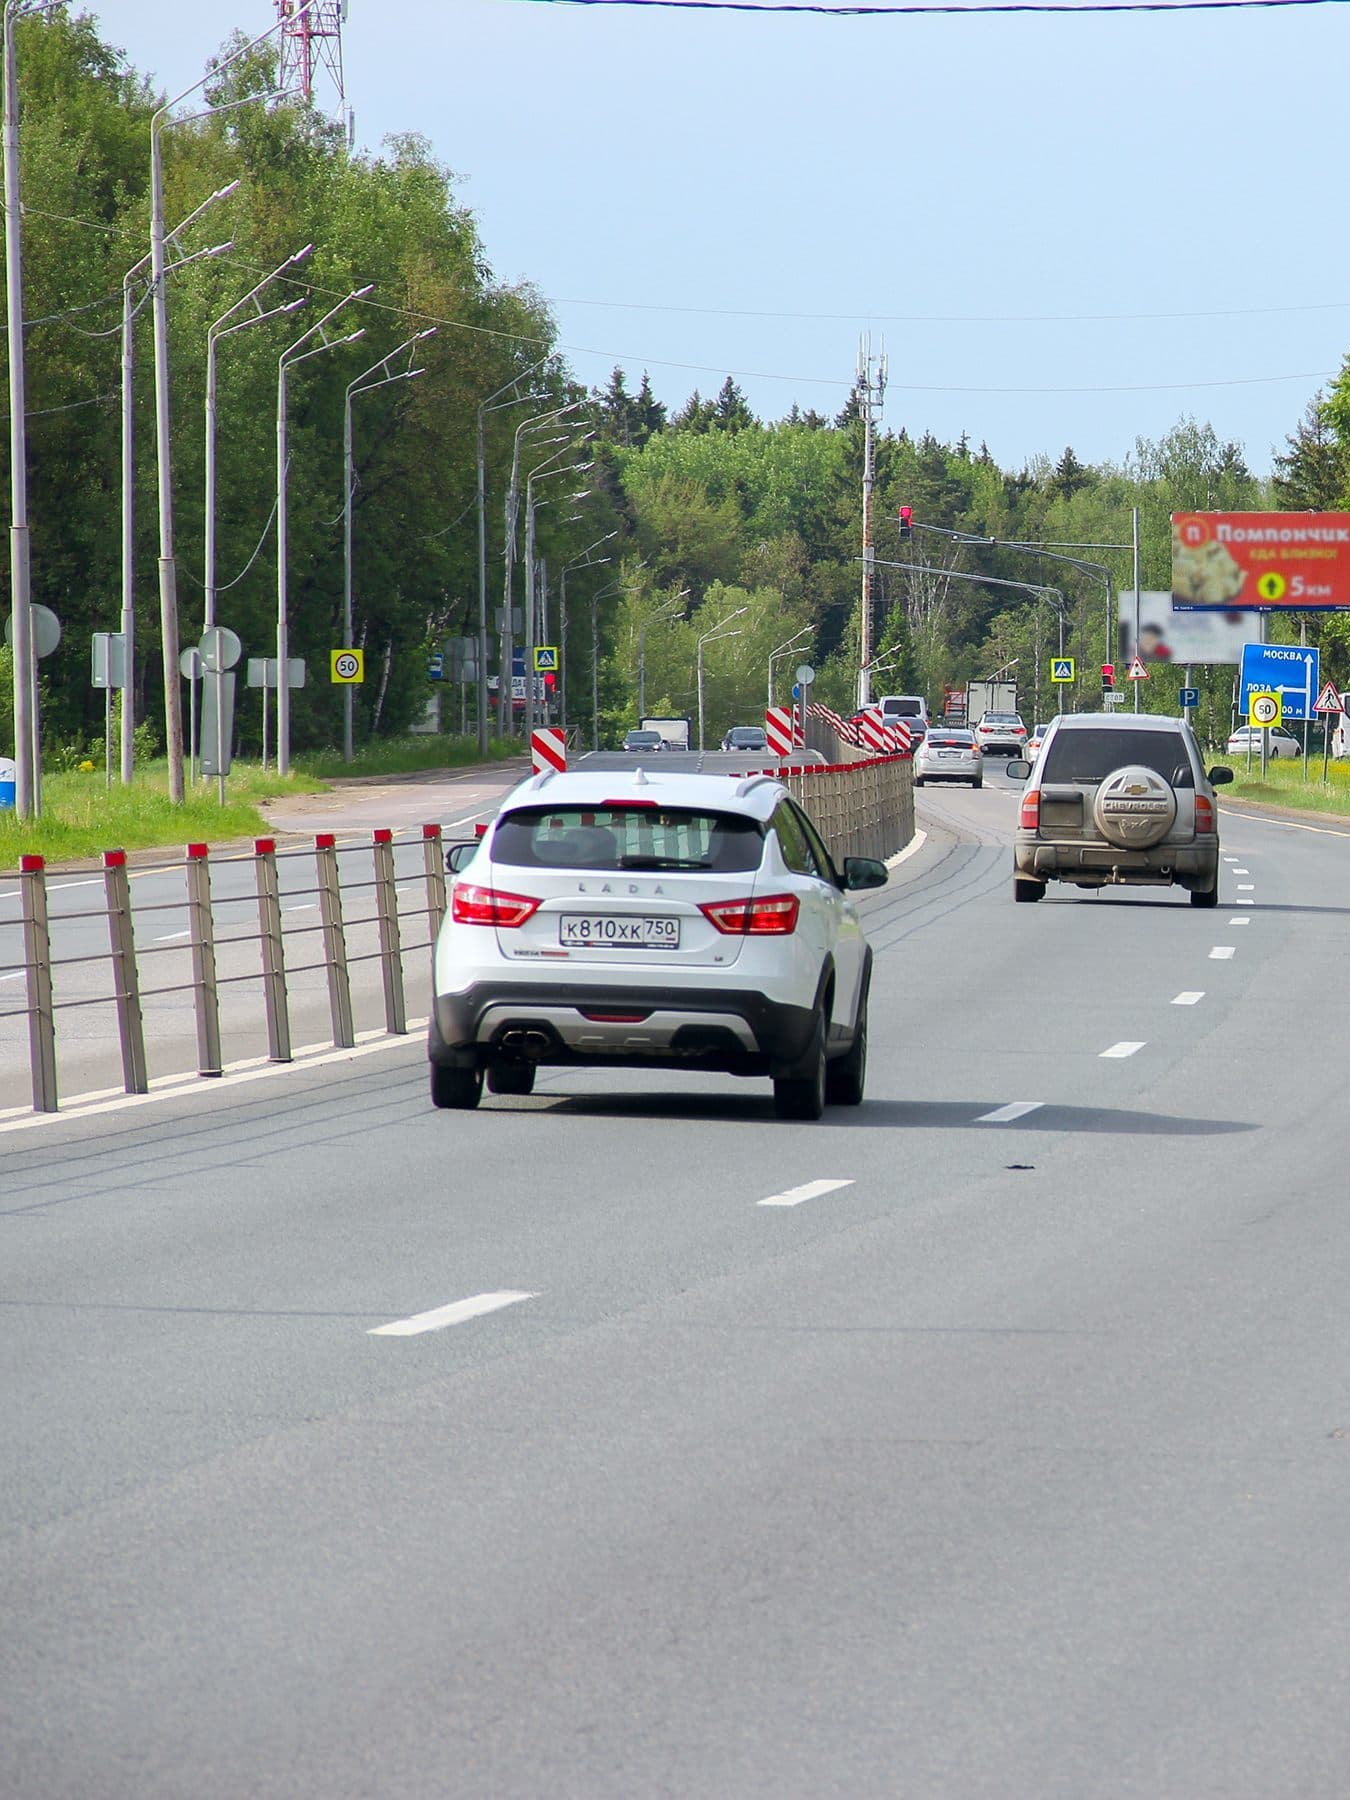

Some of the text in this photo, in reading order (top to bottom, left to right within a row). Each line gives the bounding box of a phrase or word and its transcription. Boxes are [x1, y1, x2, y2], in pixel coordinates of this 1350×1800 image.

[1216, 524, 1350, 542] Помпончик
[1290, 575, 1304, 597] 5
[1263, 649, 1303, 661] МОСКВА
[340, 660, 355, 672] 50
[1246, 682, 1272, 692] ЛОЗА
[1184, 690, 1196, 705] P
[1258, 704, 1272, 715] 50
[1281, 705, 1293, 715] 00
[578, 883, 664, 895] LADA
[645, 920, 674, 935] 750
